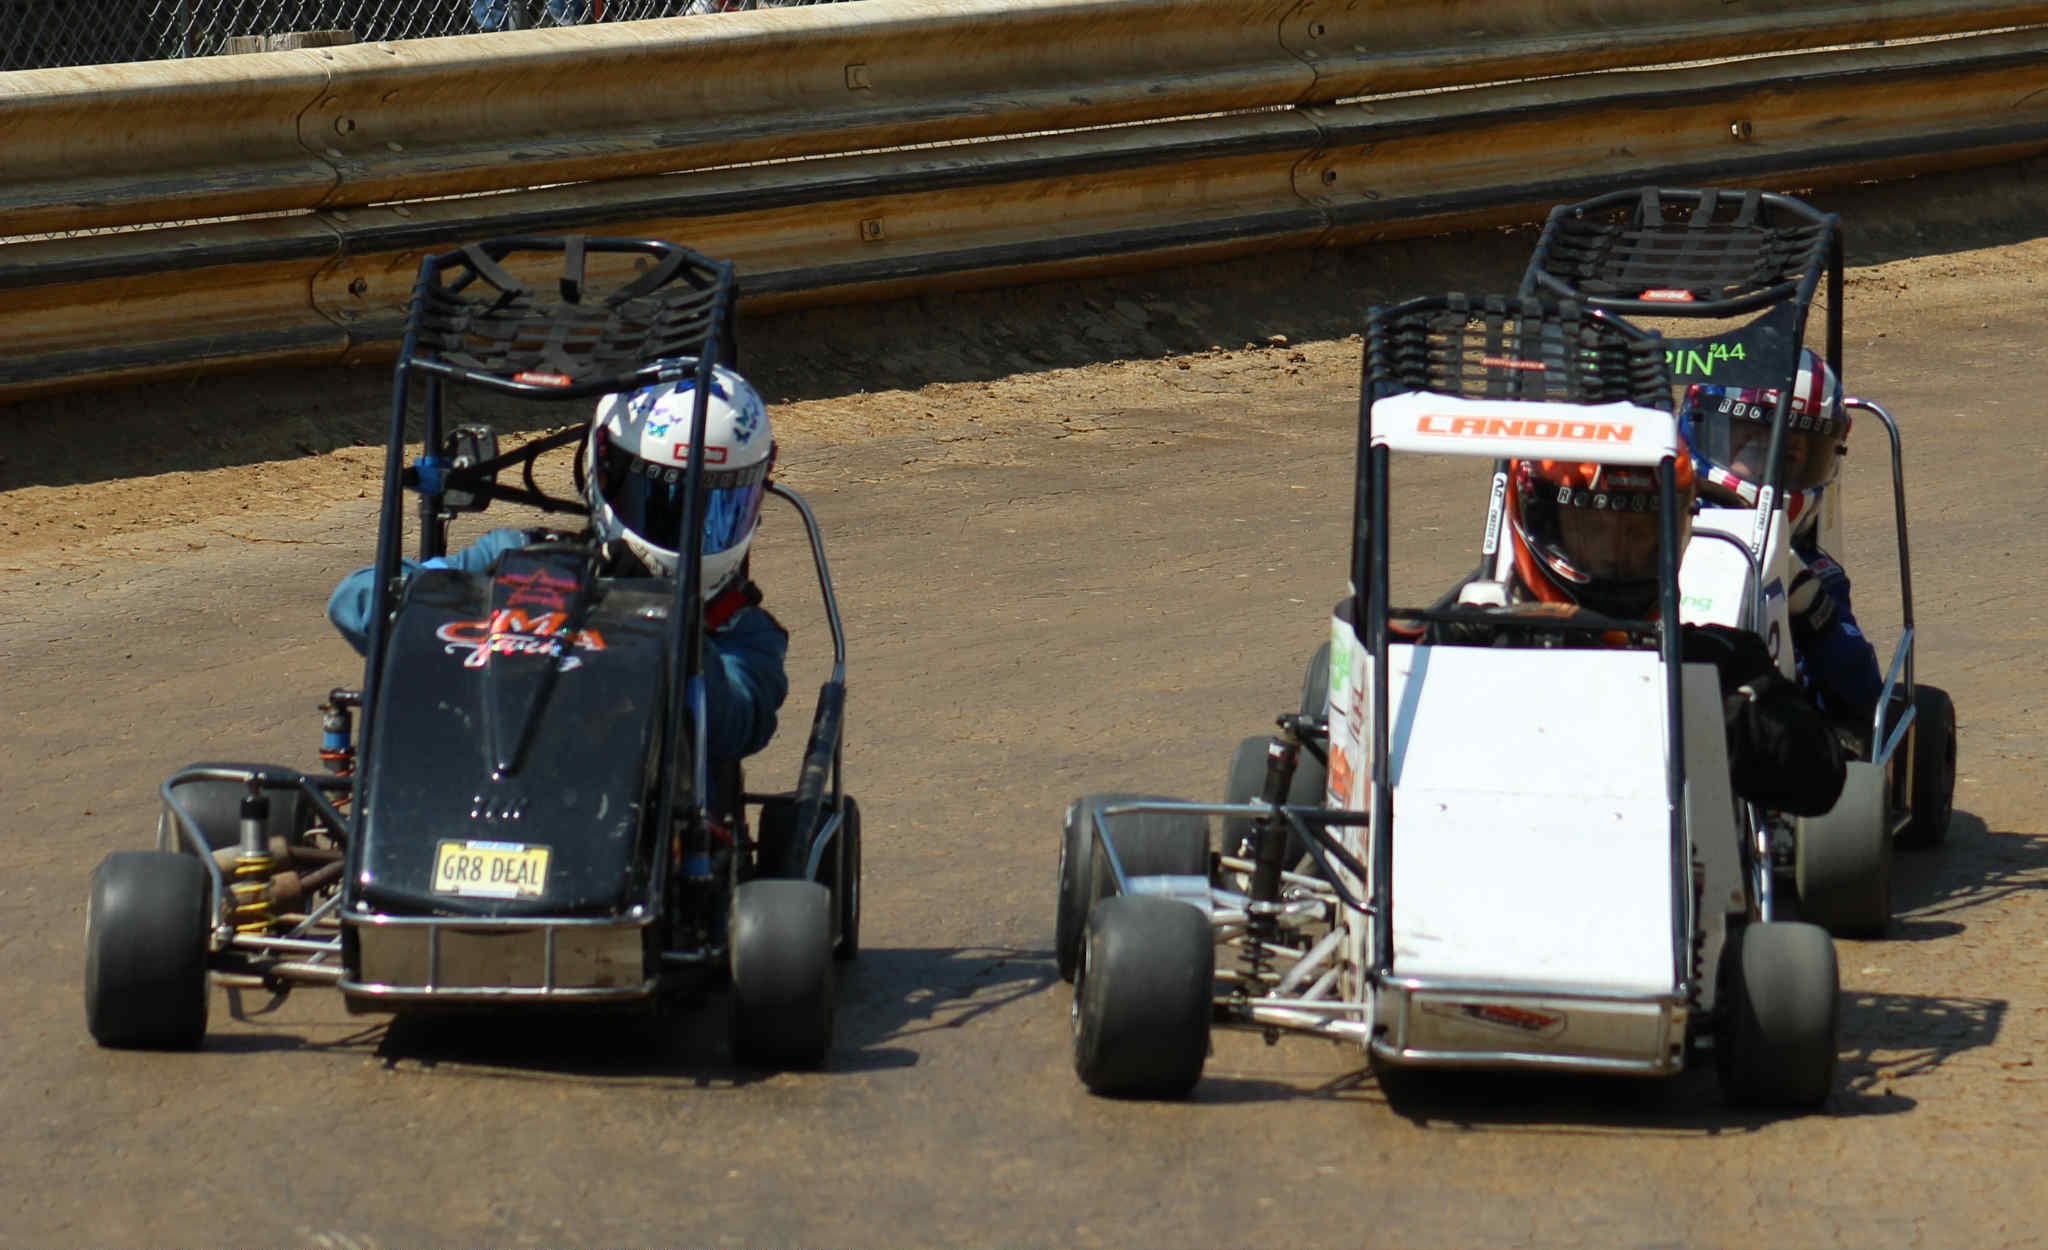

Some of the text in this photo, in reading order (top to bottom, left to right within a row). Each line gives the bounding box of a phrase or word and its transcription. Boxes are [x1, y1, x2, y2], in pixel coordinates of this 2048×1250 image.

[1416, 414, 1634, 445] LANDON
[443, 854, 539, 885] GR8 DEAL
